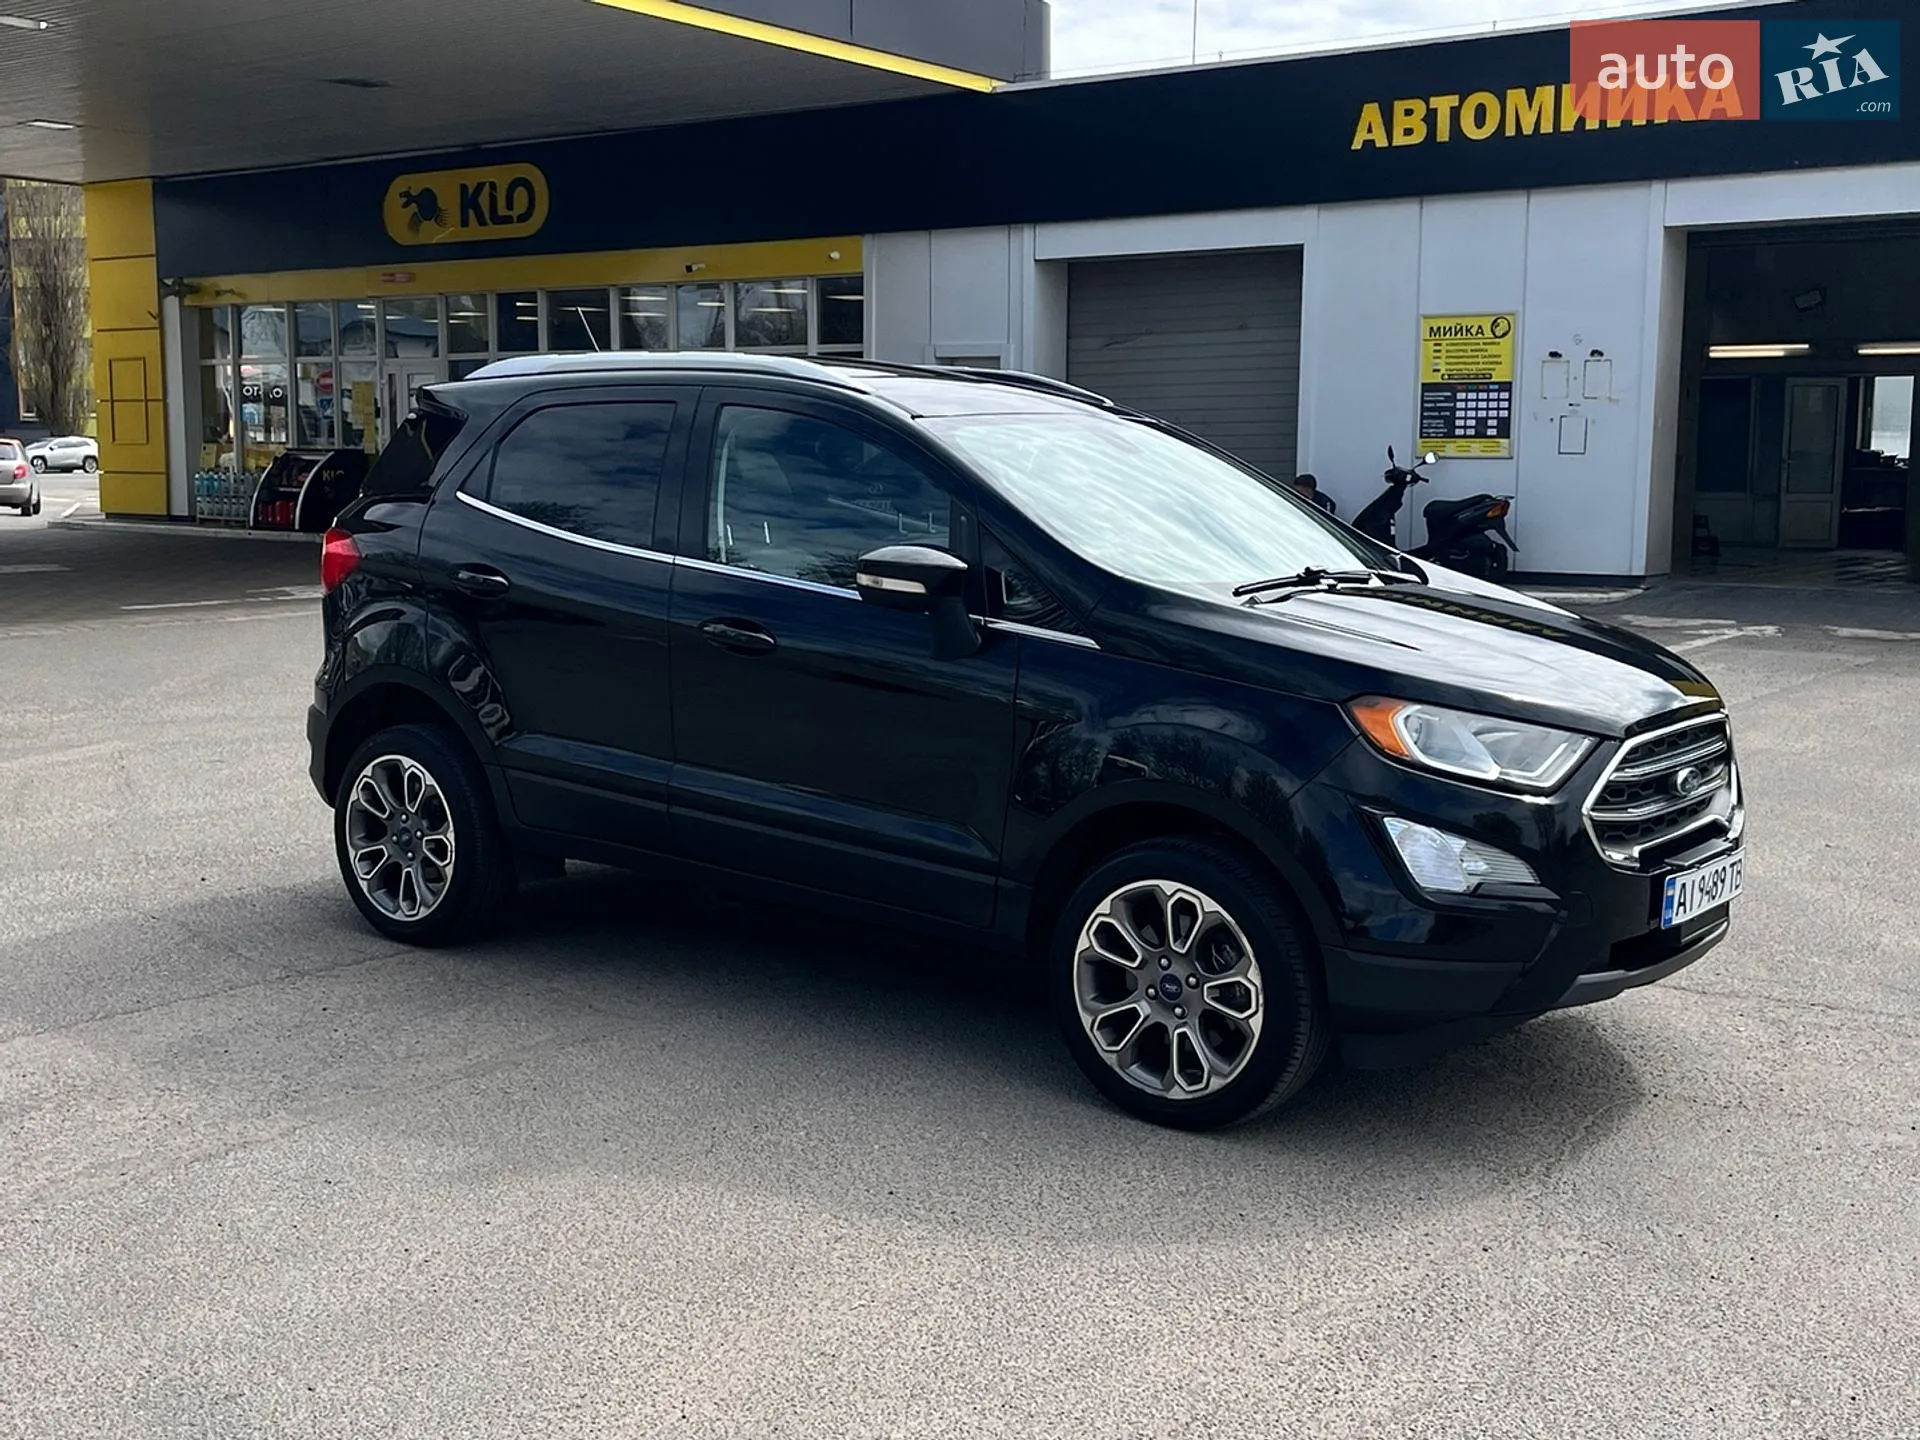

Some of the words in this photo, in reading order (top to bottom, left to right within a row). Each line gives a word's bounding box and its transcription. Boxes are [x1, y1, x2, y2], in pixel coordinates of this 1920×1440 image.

[1351, 64, 1743, 150] АВТОМИЙКА
[460, 177, 536, 228] KLO
[1429, 323, 1485, 338] МИЙКА
